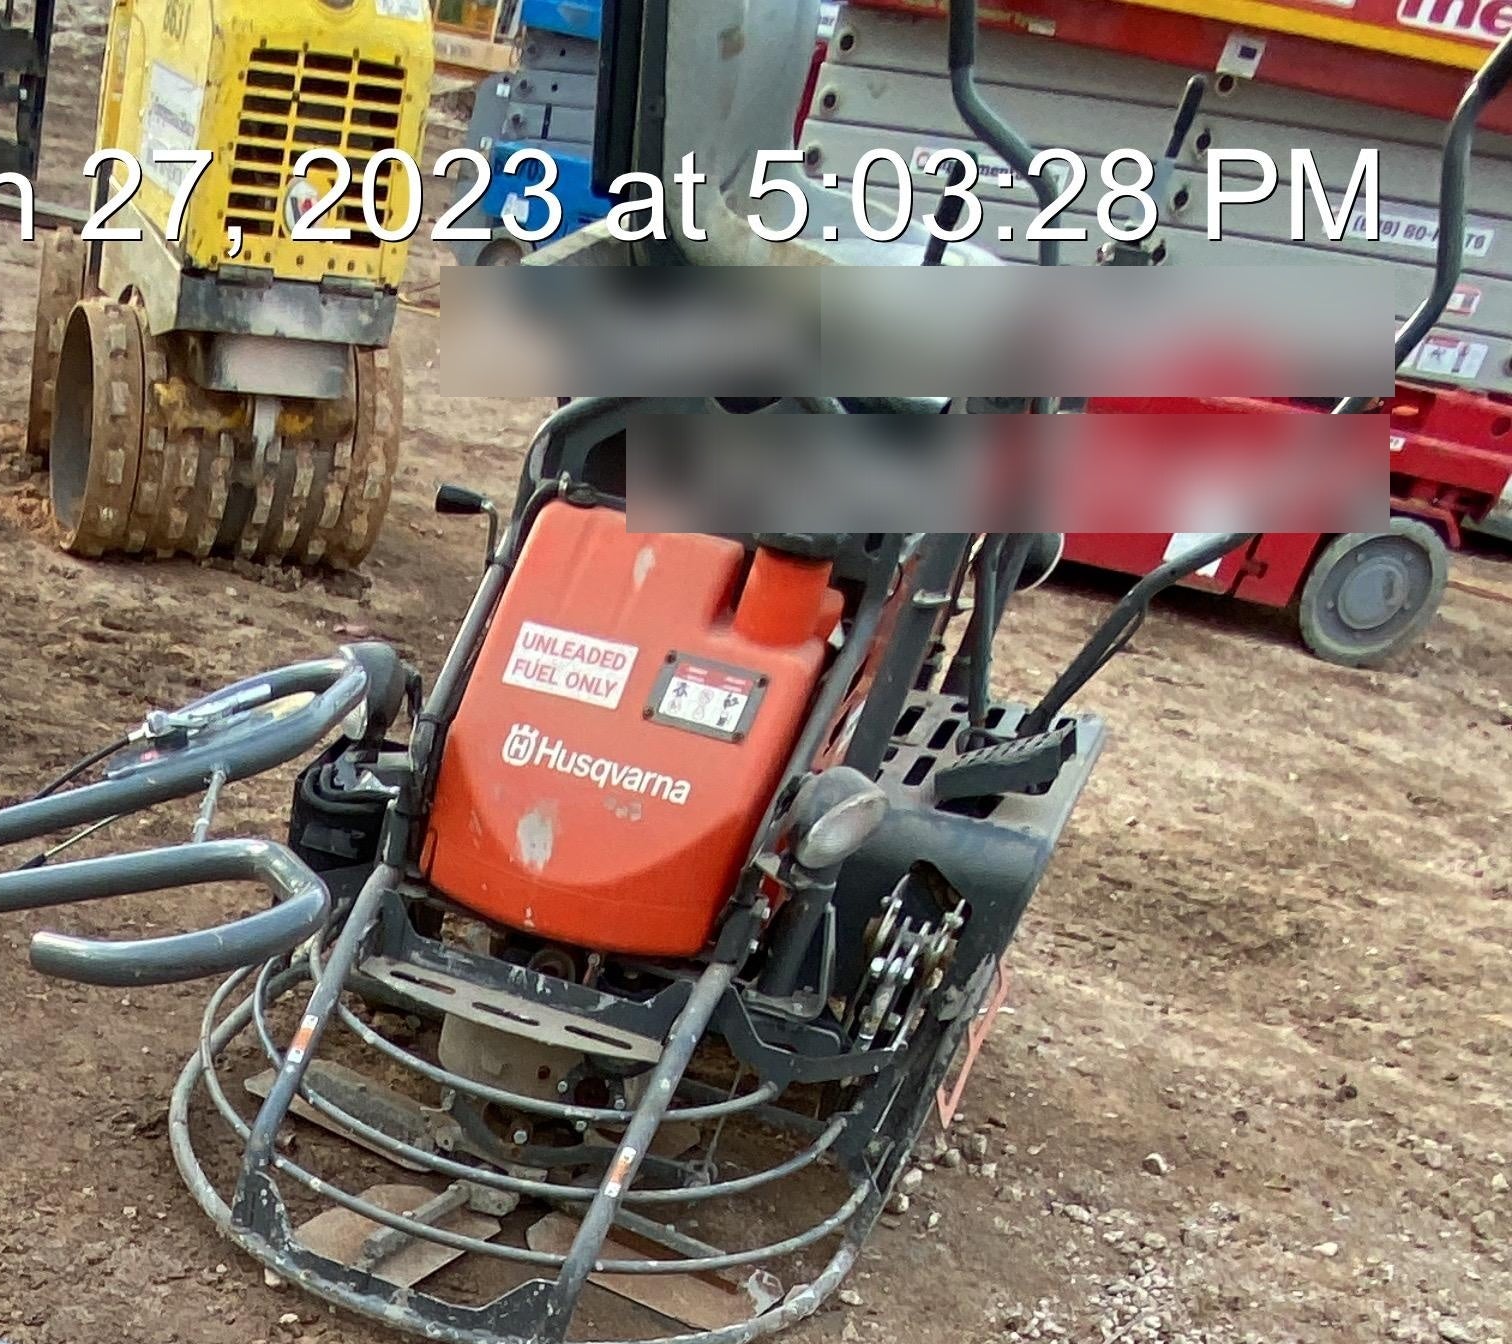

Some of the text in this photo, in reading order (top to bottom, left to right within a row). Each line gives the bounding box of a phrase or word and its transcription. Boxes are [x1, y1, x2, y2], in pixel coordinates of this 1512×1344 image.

[521, 630, 628, 673] UNLEADED
[510, 657, 619, 699] FUEL ONLY
[535, 736, 692, 806] Husqvarna
